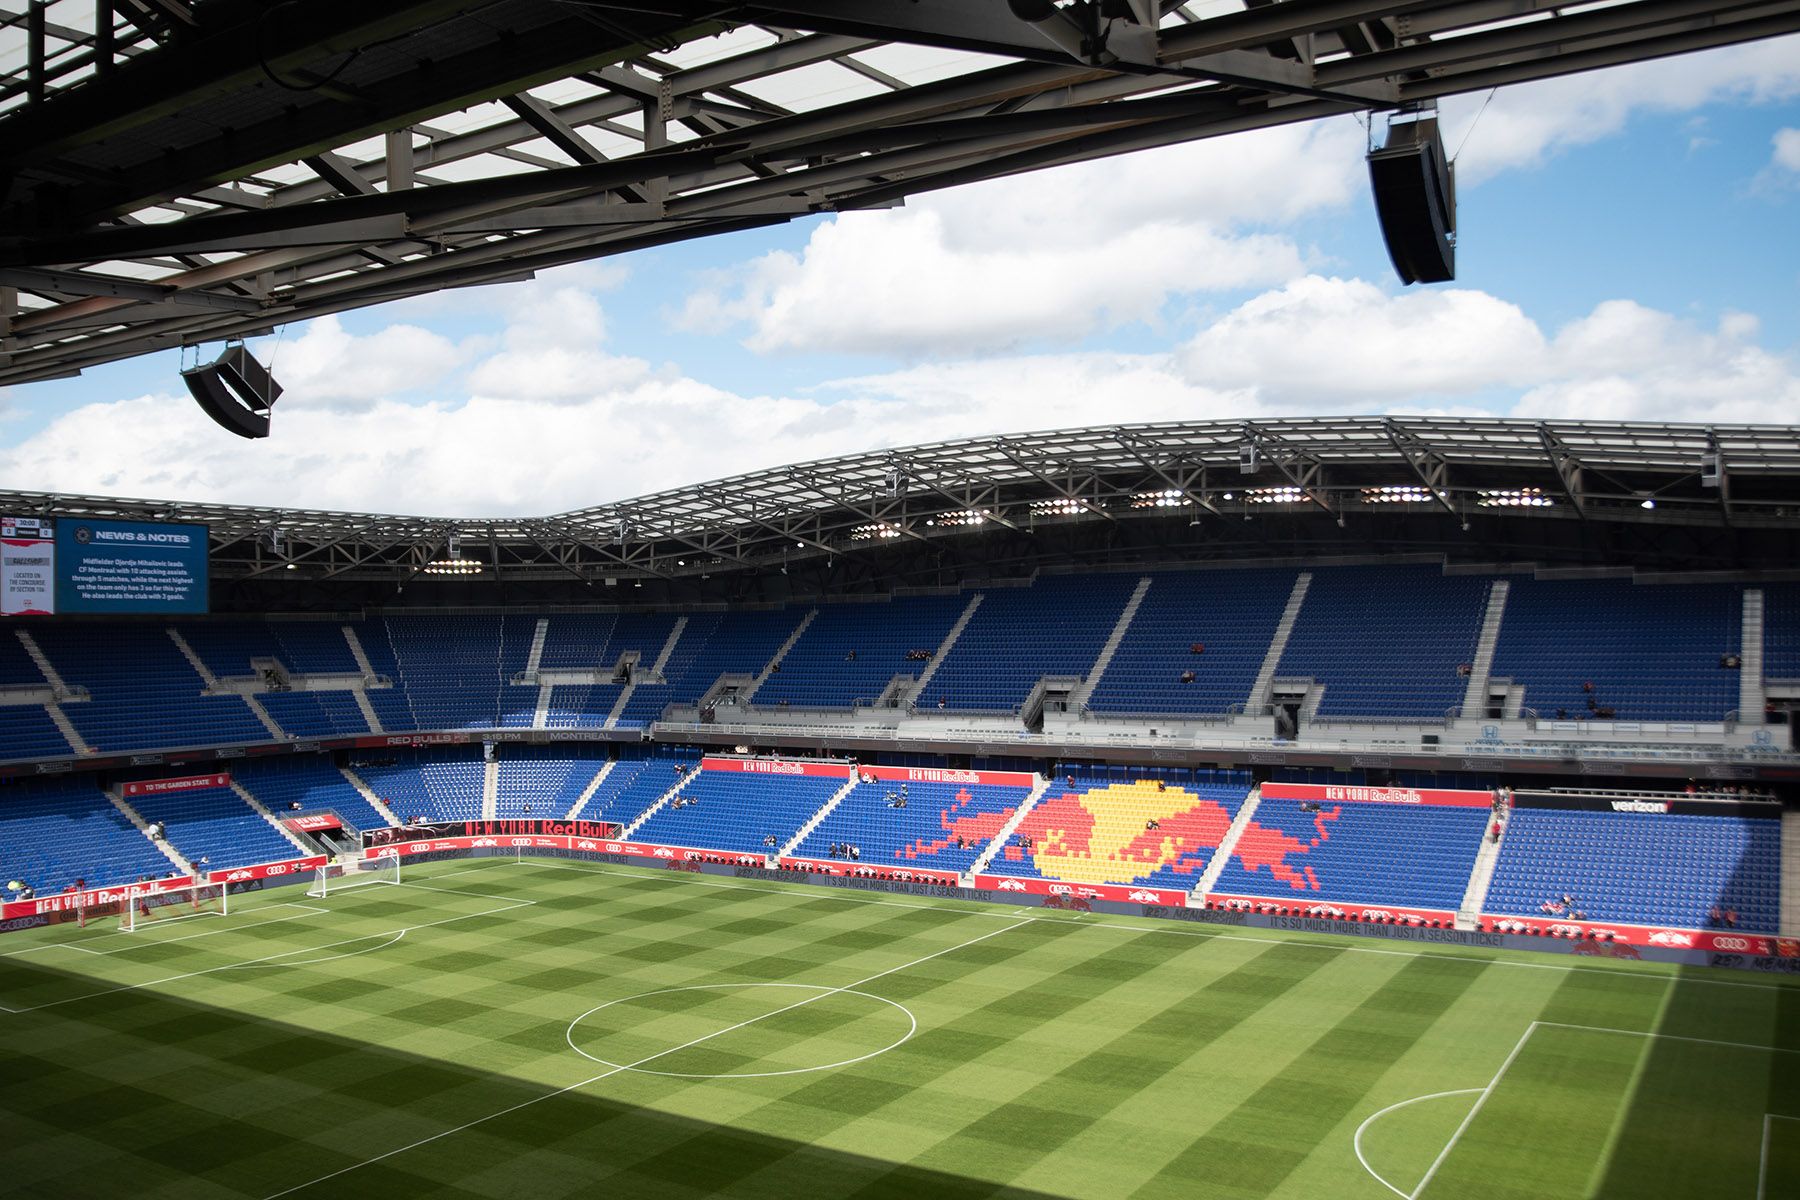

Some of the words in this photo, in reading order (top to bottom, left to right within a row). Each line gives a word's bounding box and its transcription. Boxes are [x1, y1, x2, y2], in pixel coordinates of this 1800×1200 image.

[95, 531, 135, 541] NEWS
[136, 533, 146, 541] &
[147, 533, 191, 543] NOTES
[137, 559, 167, 567] Mihailovic
[88, 566, 116, 574] Montreal
[139, 568, 166, 576] attacking
[71, 575, 97, 583] through
[171, 577, 193, 585] highest
[113, 584, 127, 592] only
[386, 736, 411, 745] RED
[412, 734, 451, 744] BULLS
[482, 733, 503, 741] 3:15
[550, 732, 612, 741] MONTREAL
[743, 761, 755, 772] NEW
[909, 769, 923, 780] NEW
[167, 781, 191, 789] GARDEN
[191, 779, 210, 787] STATE
[1326, 787, 1343, 800] NEW
[1345, 788, 1369, 801] YORK
[1611, 800, 1668, 814] verizon
[465, 820, 494, 837] NEW
[499, 820, 536, 836] YORK
[543, 820, 577, 836] Red
[580, 822, 616, 839] Bulls
[824, 876, 837, 886] IT'S
[838, 877, 848, 887] SO
[850, 878, 869, 888] MUCH
[870, 880, 889, 890] MORE
[891, 882, 909, 892] THAN
[910, 884, 928, 894] JUST
[930, 886, 936, 895] A
[937, 886, 965, 898] SEASON
[968, 890, 992, 901] TICKET
[35, 898, 60, 914] NEW
[1270, 916, 1288, 928] IT'S
[1290, 917, 1301, 929] SO
[1304, 918, 1331, 931] MUCH
[1334, 921, 1361, 935] MORE
[1363, 923, 1389, 937] THAN
[1391, 926, 1415, 939] JUST
[1417, 928, 1425, 940] A
[1427, 929, 1467, 943] SEASON
[1470, 932, 1505, 946] TICKET
